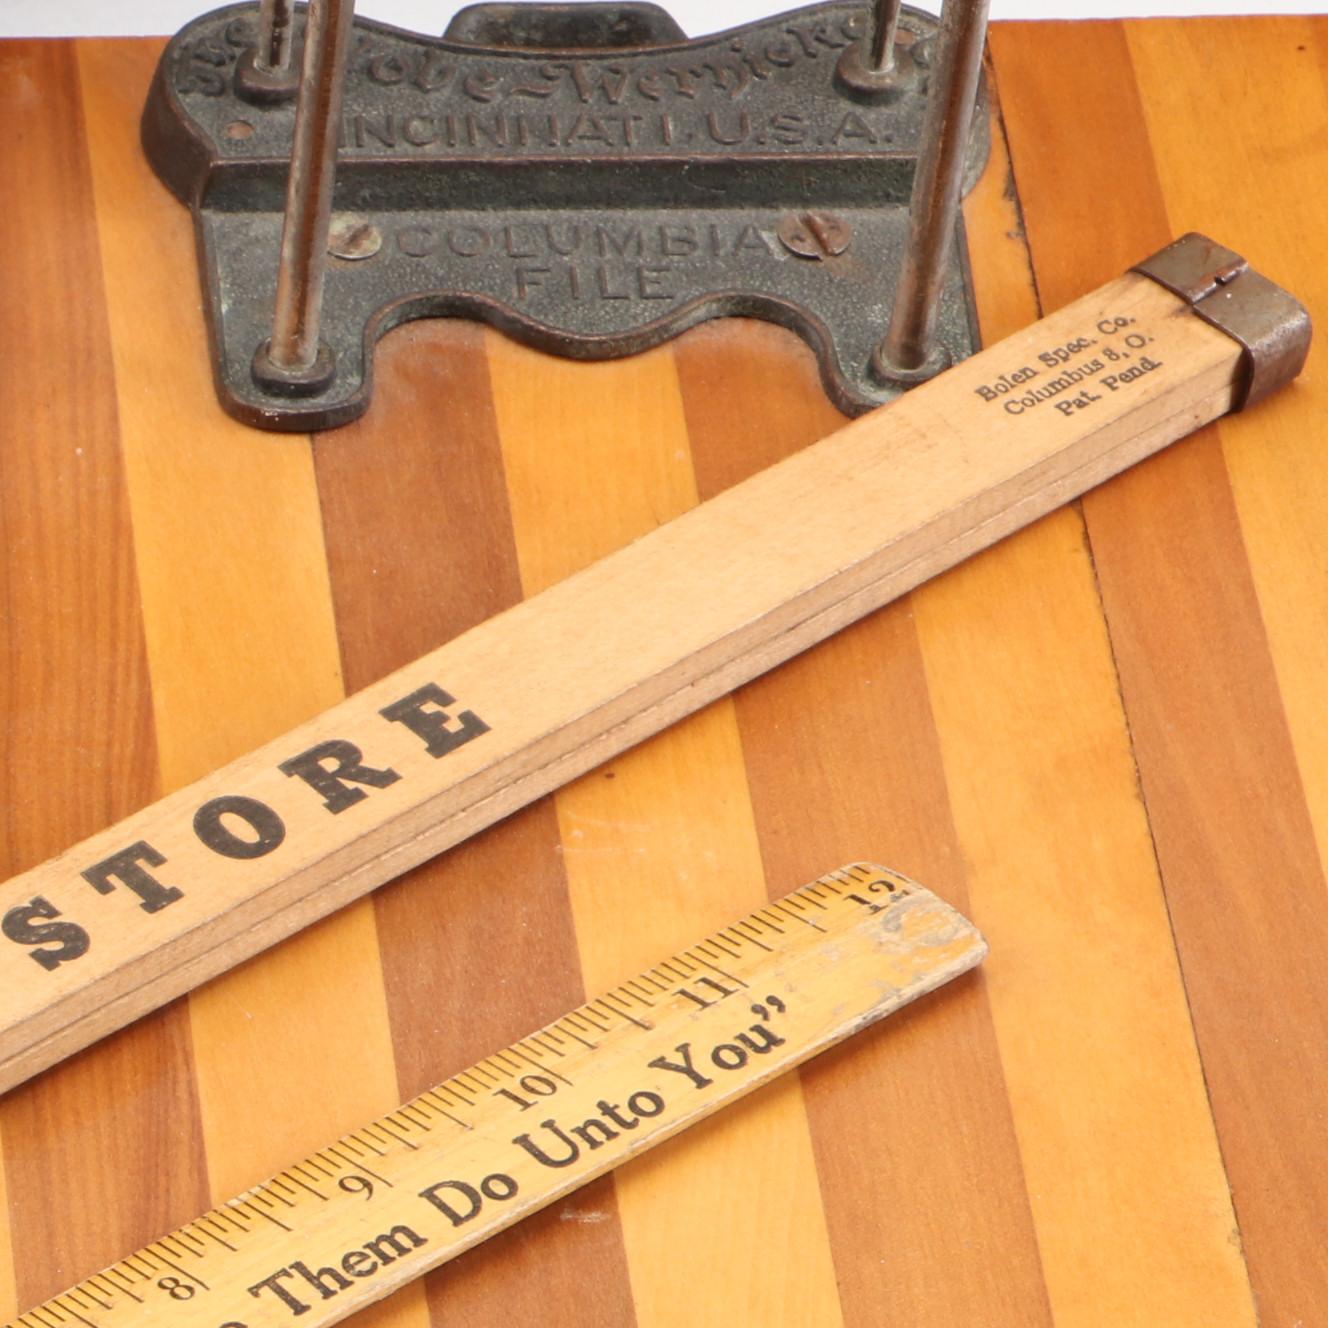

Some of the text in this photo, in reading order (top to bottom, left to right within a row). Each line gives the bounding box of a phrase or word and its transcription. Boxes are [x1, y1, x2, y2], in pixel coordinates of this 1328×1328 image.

[396, 222, 777, 259] COLUMBIA
[514, 264, 676, 302] FILE
[975, 314, 1137, 402] Bolen Spec. Co.
[1003, 333, 1155, 416] Columbus 8, O.
[1054, 390, 1101, 417] Pat.
[1, 682, 491, 971] STORE
[157, 1276, 197, 1302] 8
[338, 1174, 375, 1202] 9
[492, 1073, 559, 1115] 10
[676, 977, 741, 1011] 11
[843, 880, 911, 915] 12
[248, 1215, 428, 1317] Them
[418, 1171, 519, 1229] Do
[511, 1087, 665, 1169] Unto
